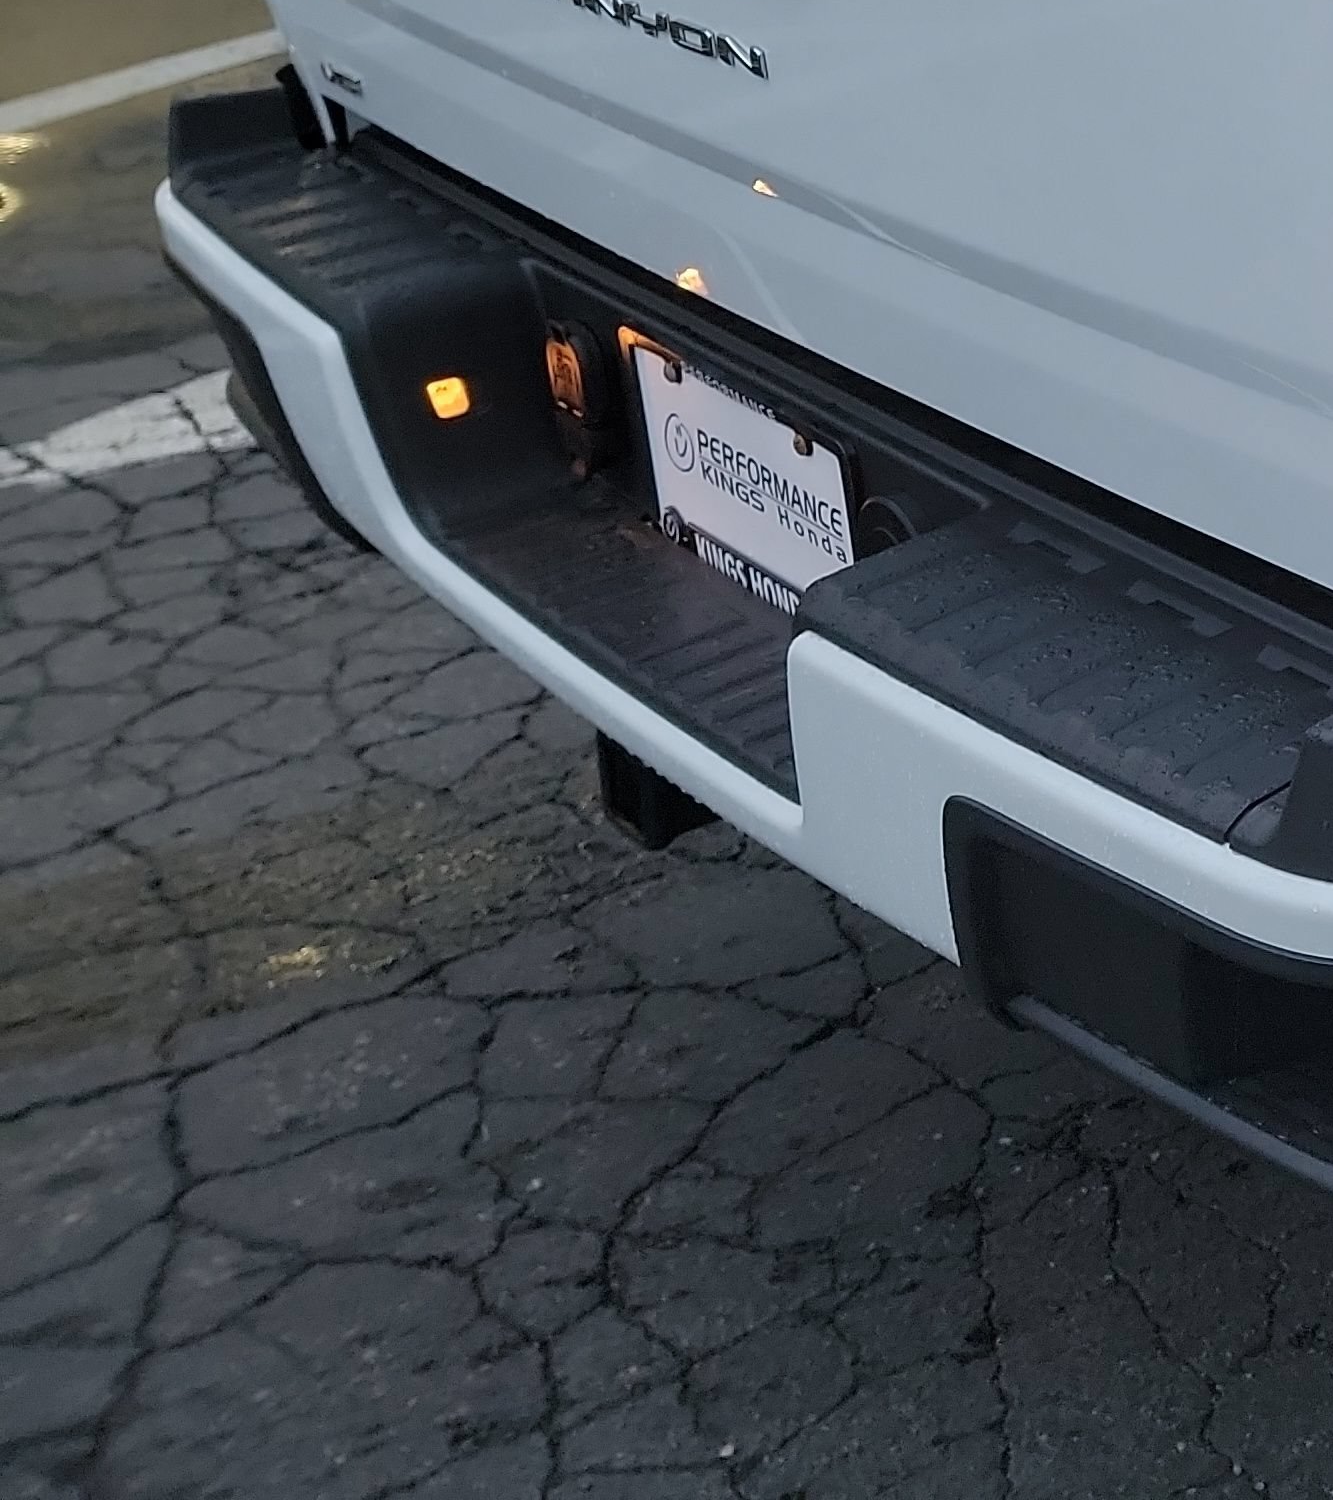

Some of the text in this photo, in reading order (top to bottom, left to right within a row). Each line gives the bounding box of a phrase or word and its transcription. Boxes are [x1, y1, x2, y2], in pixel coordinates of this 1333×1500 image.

[697, 429, 843, 537] PERFORMANCE
[701, 462, 848, 563] KINGS Honda
[695, 533, 748, 588] KINGS
